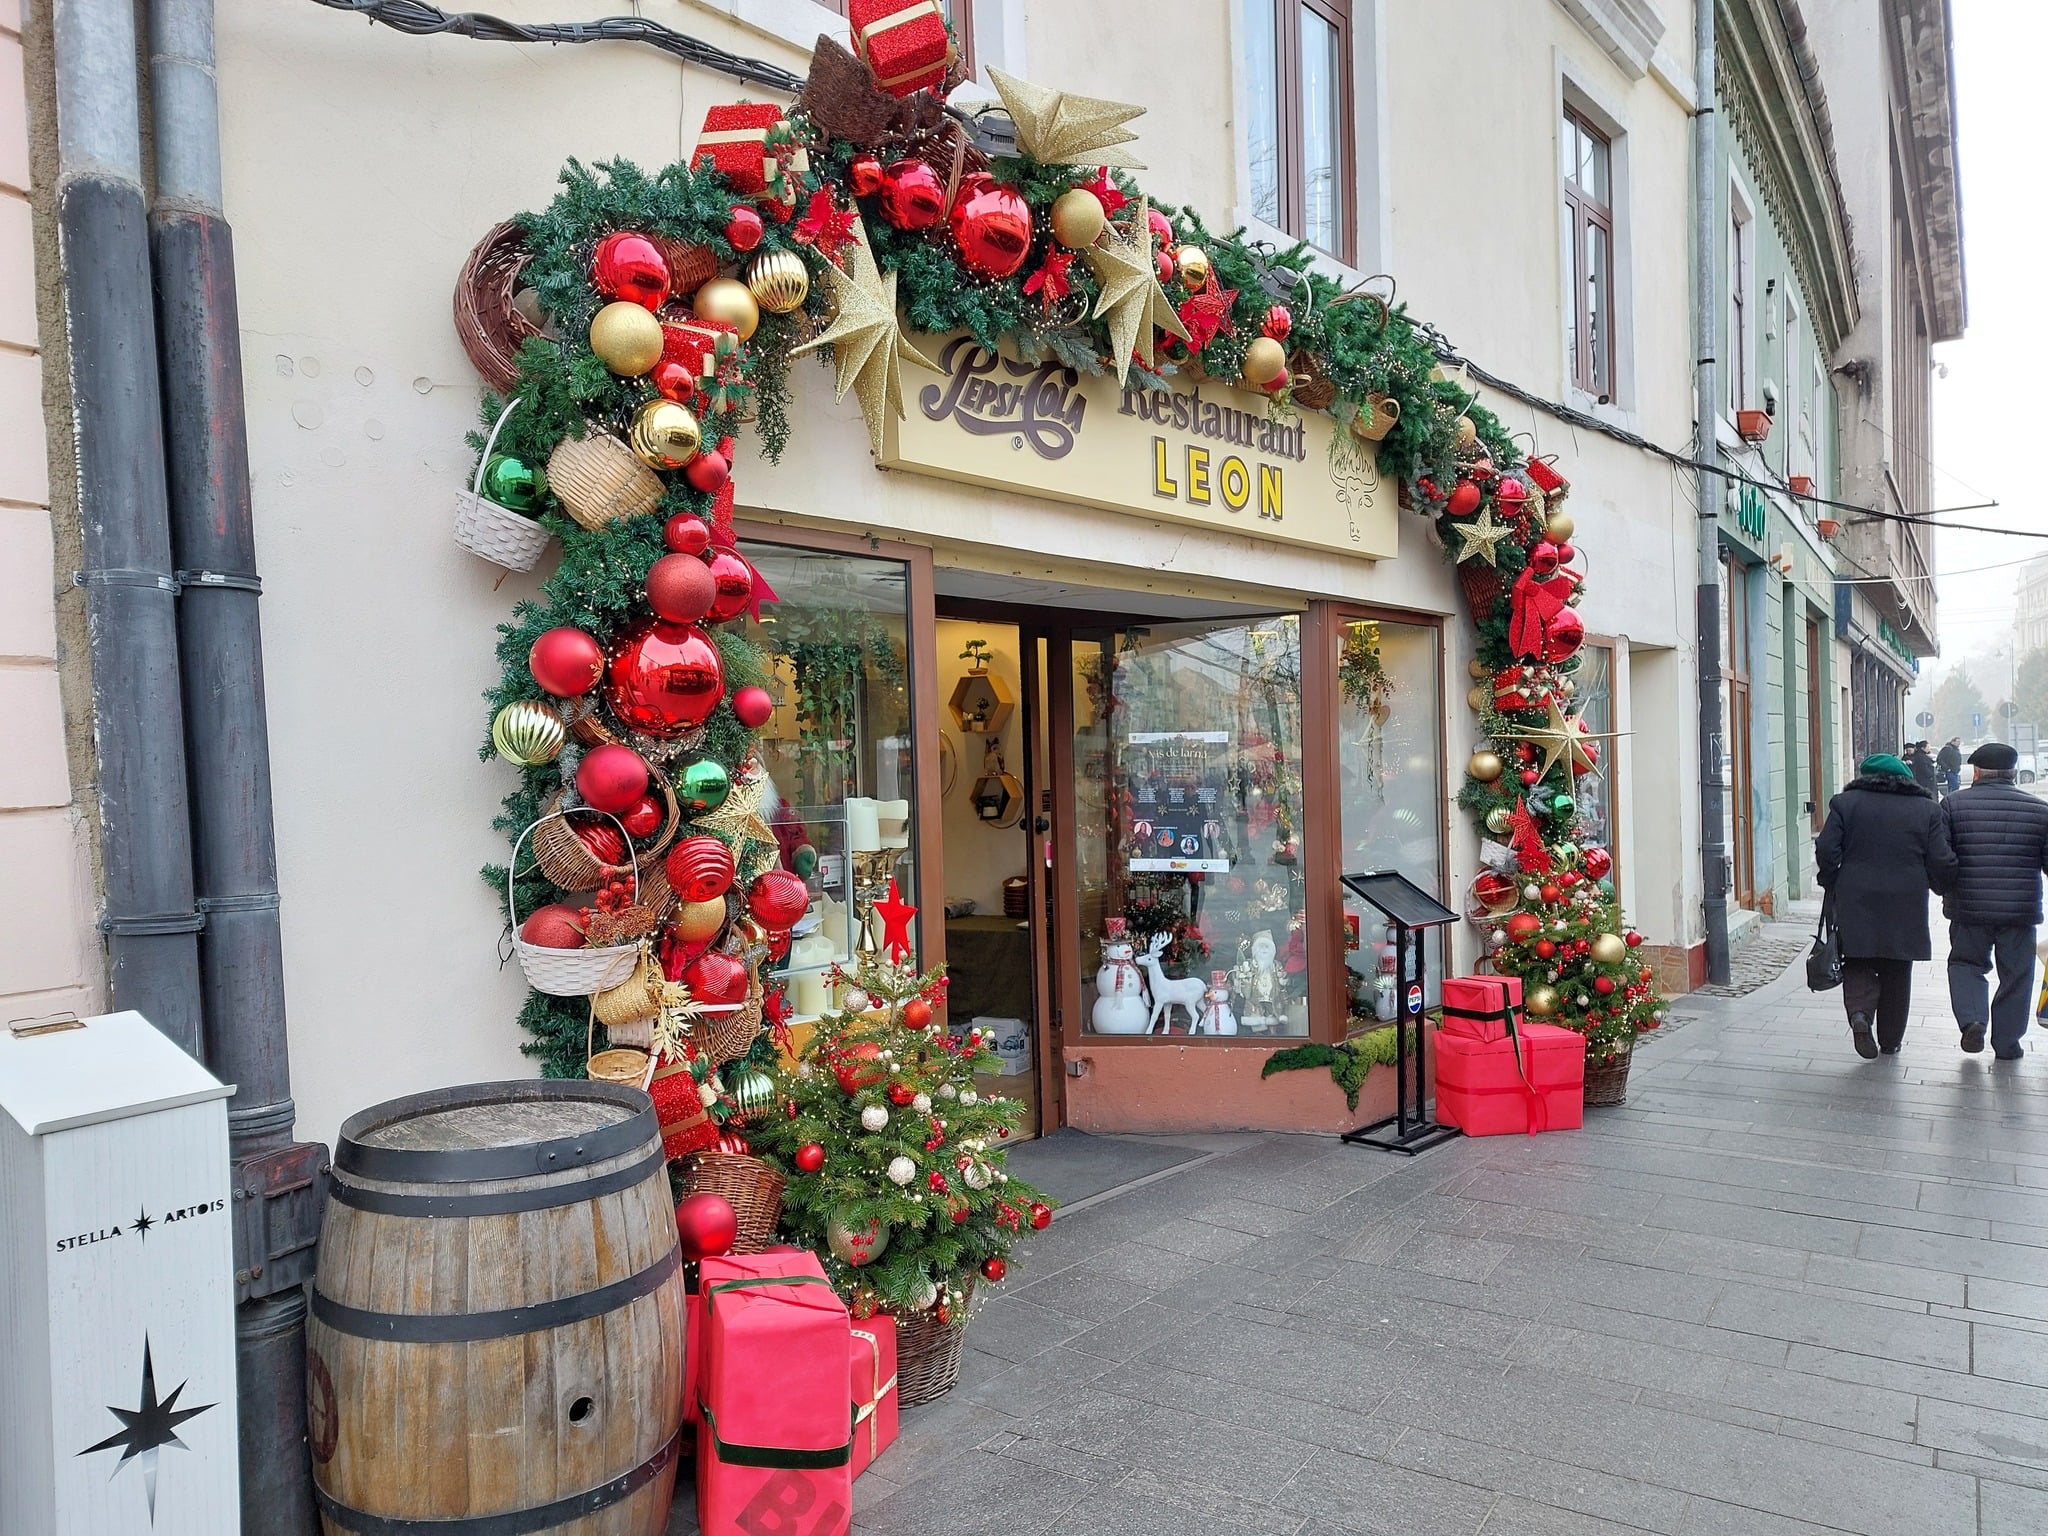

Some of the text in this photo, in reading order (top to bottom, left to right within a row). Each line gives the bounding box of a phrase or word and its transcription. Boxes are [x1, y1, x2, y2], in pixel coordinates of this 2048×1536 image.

[1118, 385, 1307, 463] Restaurant
[1151, 435, 1284, 521] LEON
[56, 1198, 225, 1253] STELLA ARTOIS
